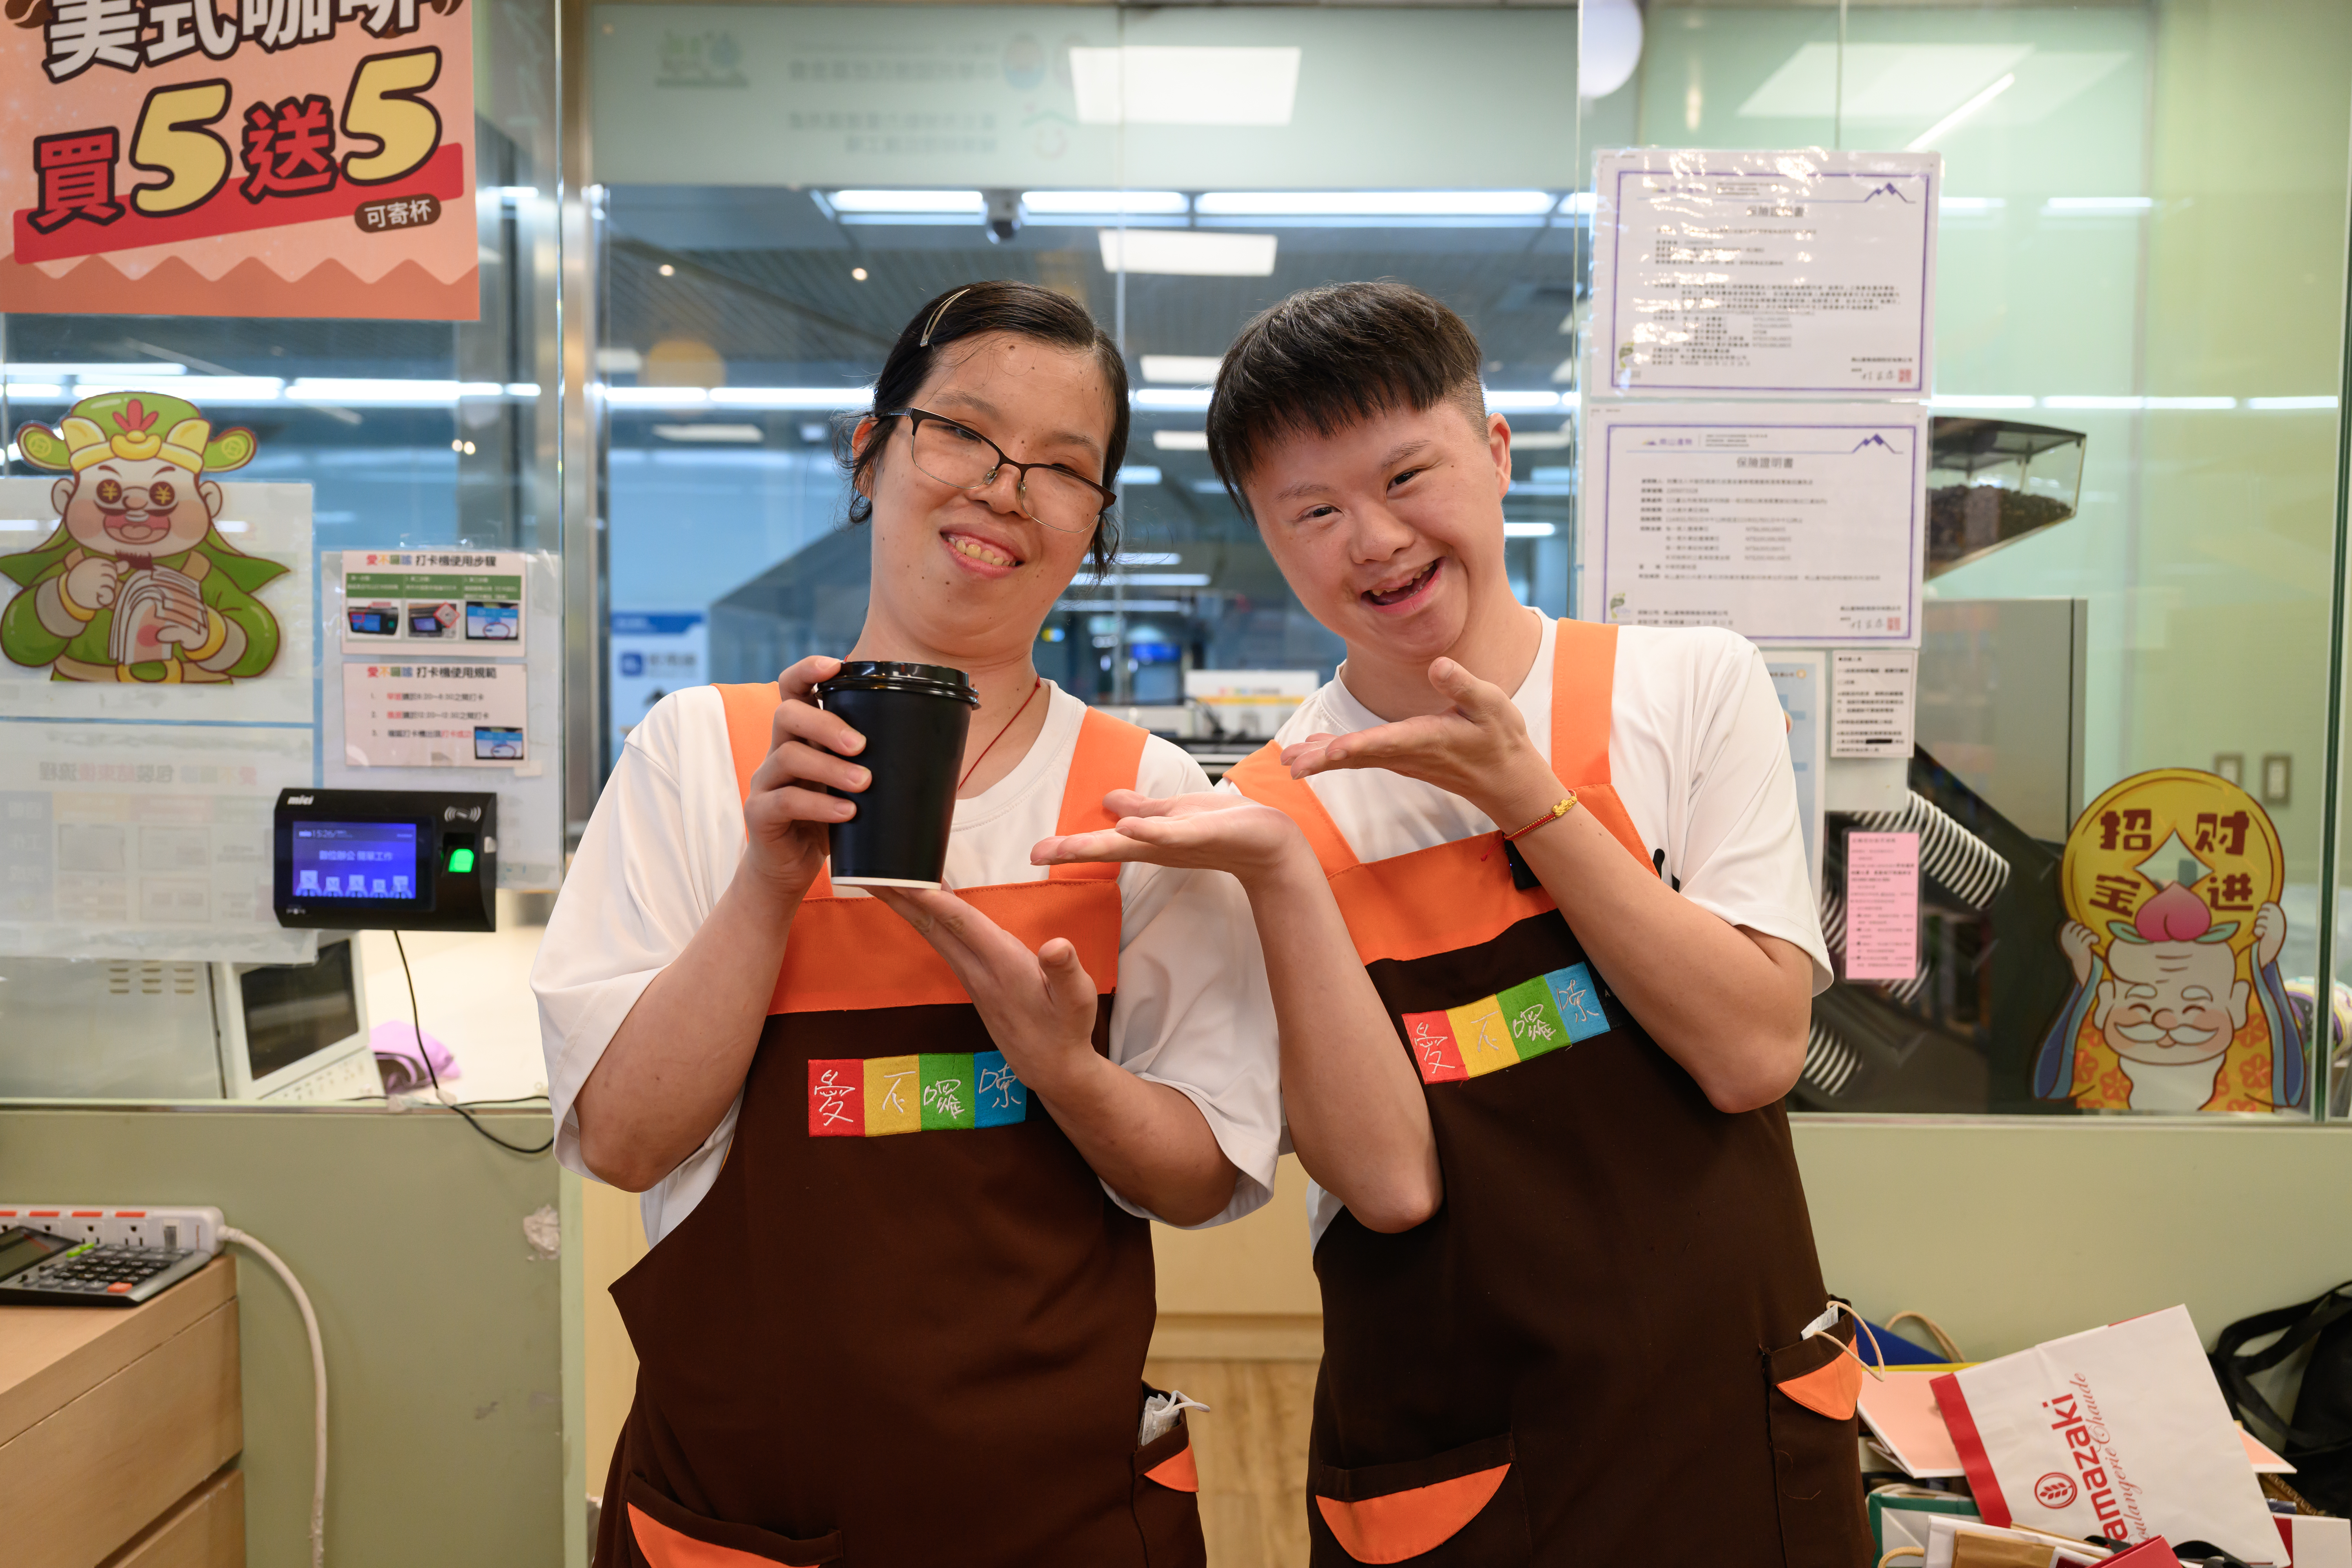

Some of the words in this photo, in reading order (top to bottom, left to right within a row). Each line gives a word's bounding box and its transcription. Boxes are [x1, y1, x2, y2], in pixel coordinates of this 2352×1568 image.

[27, 45, 443, 234] 買5送5
[364, 199, 432, 229] 可寄杯
[2042, 1392, 2129, 1542] amazaki
[2069, 1372, 2111, 1453] Chaude
